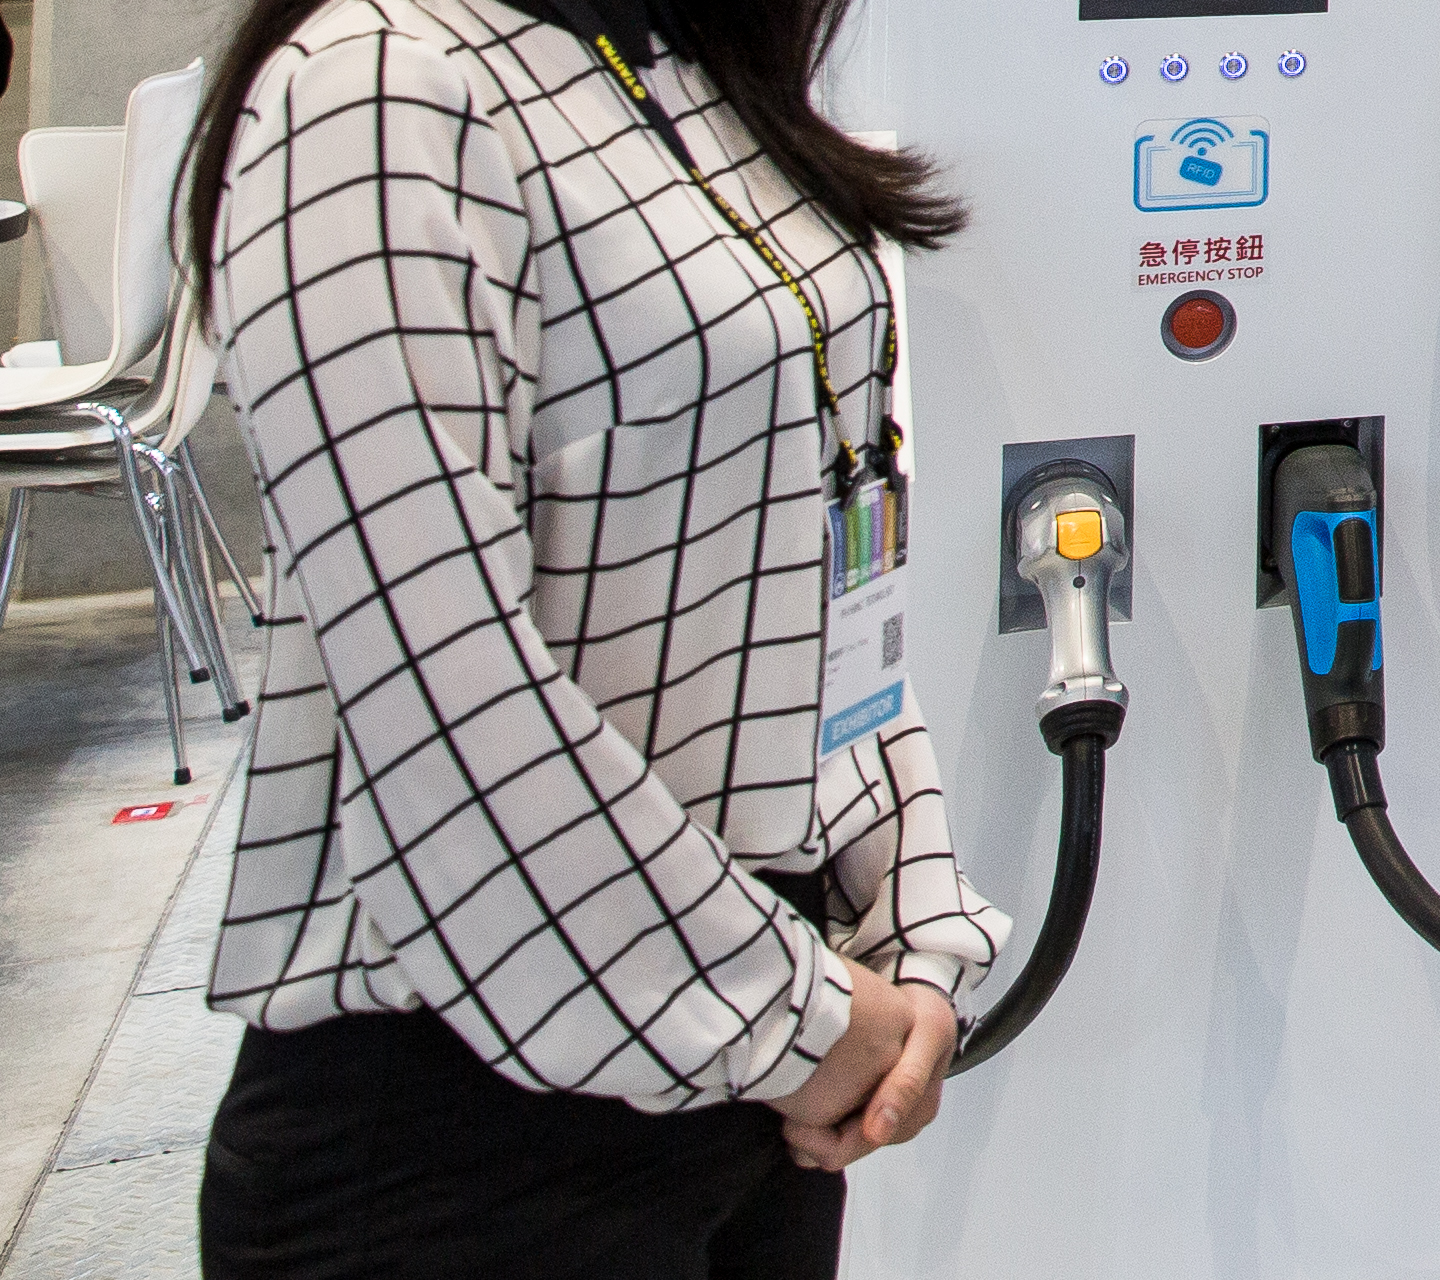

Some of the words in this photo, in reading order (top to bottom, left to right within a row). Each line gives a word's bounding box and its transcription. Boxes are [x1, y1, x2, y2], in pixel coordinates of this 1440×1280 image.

[1187, 163, 1215, 180] RFID
[1139, 234, 1264, 268] 急停按鈕
[1138, 268, 1225, 287] EMERGENCY
[1227, 266, 1265, 280] STOP
